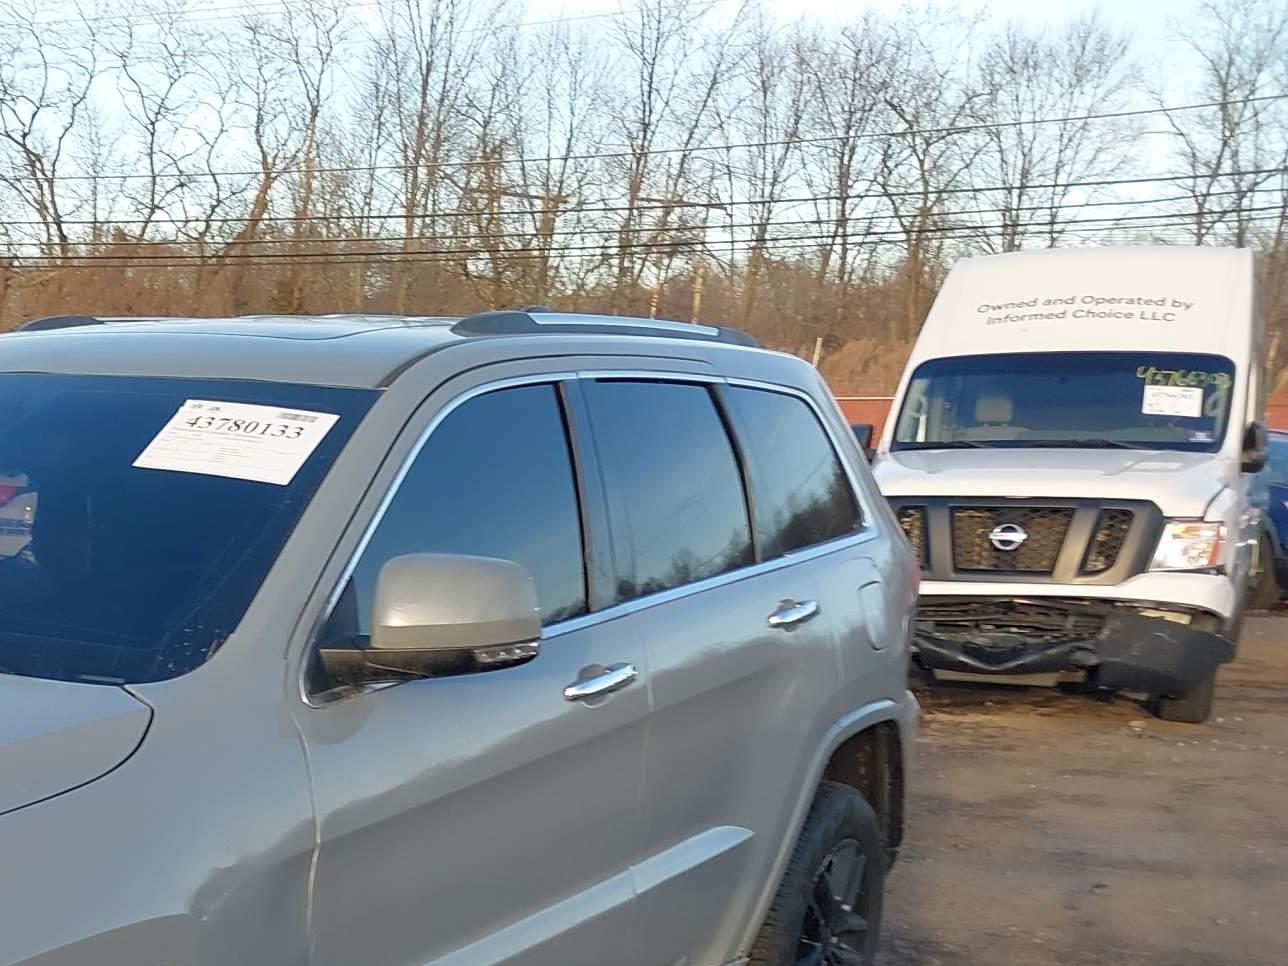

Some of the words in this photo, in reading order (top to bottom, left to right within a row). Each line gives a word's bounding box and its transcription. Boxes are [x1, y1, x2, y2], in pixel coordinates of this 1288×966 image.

[976, 298, 1039, 313] Owned
[1042, 296, 1076, 305] and
[1080, 295, 1166, 307] Operated
[1171, 298, 1195, 310] by
[986, 309, 1067, 325] Informed
[1071, 309, 1135, 319] Choice
[1139, 311, 1176, 321] LLC
[186, 415, 305, 440] 43780133
